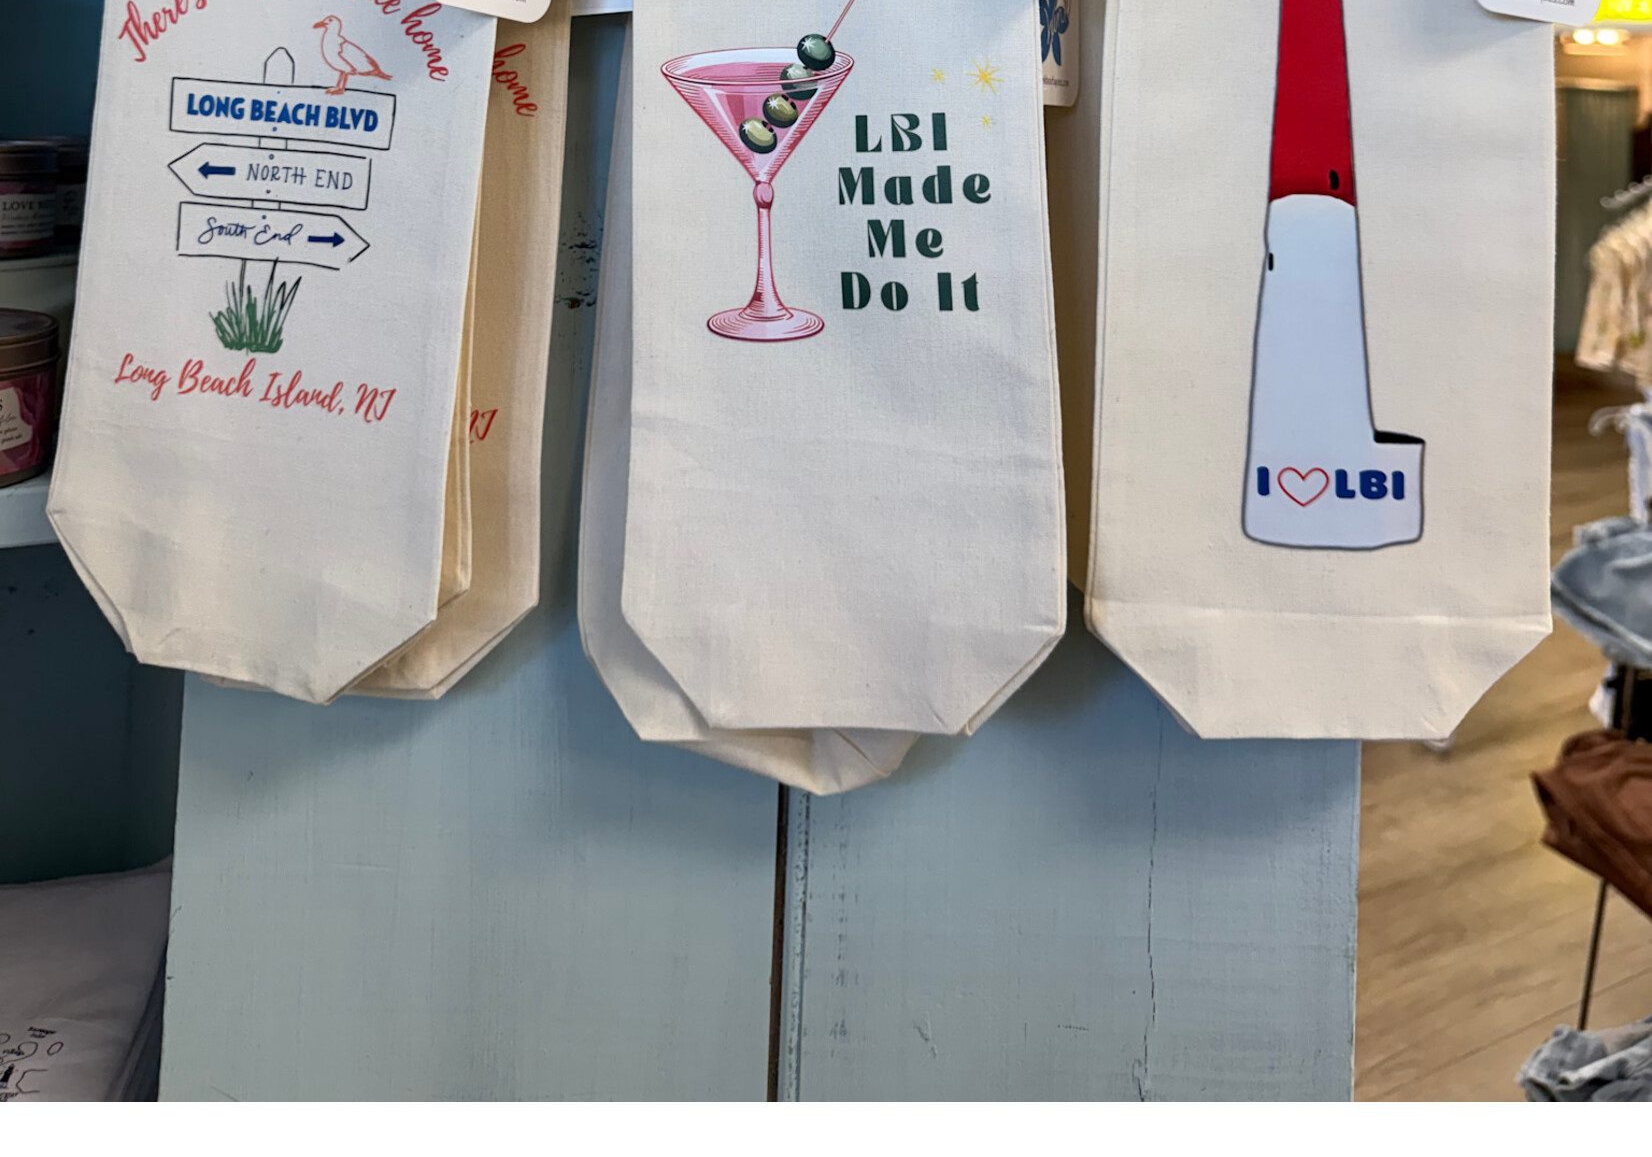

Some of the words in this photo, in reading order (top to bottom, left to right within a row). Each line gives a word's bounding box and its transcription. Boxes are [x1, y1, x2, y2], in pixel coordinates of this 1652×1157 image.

[401, 3, 451, 82] home
[187, 93, 246, 120] LONG
[250, 97, 320, 128] BEACH
[325, 106, 379, 133] BLVD
[855, 112, 949, 152] LBI
[246, 163, 307, 186] NORTH
[314, 169, 353, 191] END
[838, 165, 992, 205] Made
[198, 217, 254, 243] South
[254, 220, 303, 245] End
[867, 219, 944, 258] Me
[841, 271, 908, 312] Do
[938, 272, 980, 312] It
[114, 353, 171, 400] Long
[178, 357, 257, 398] Beach
[259, 371, 345, 416] Island,
[355, 386, 396, 422] NJ
[1256, 466, 1269, 496] I
[1335, 468, 1405, 500] LBI
